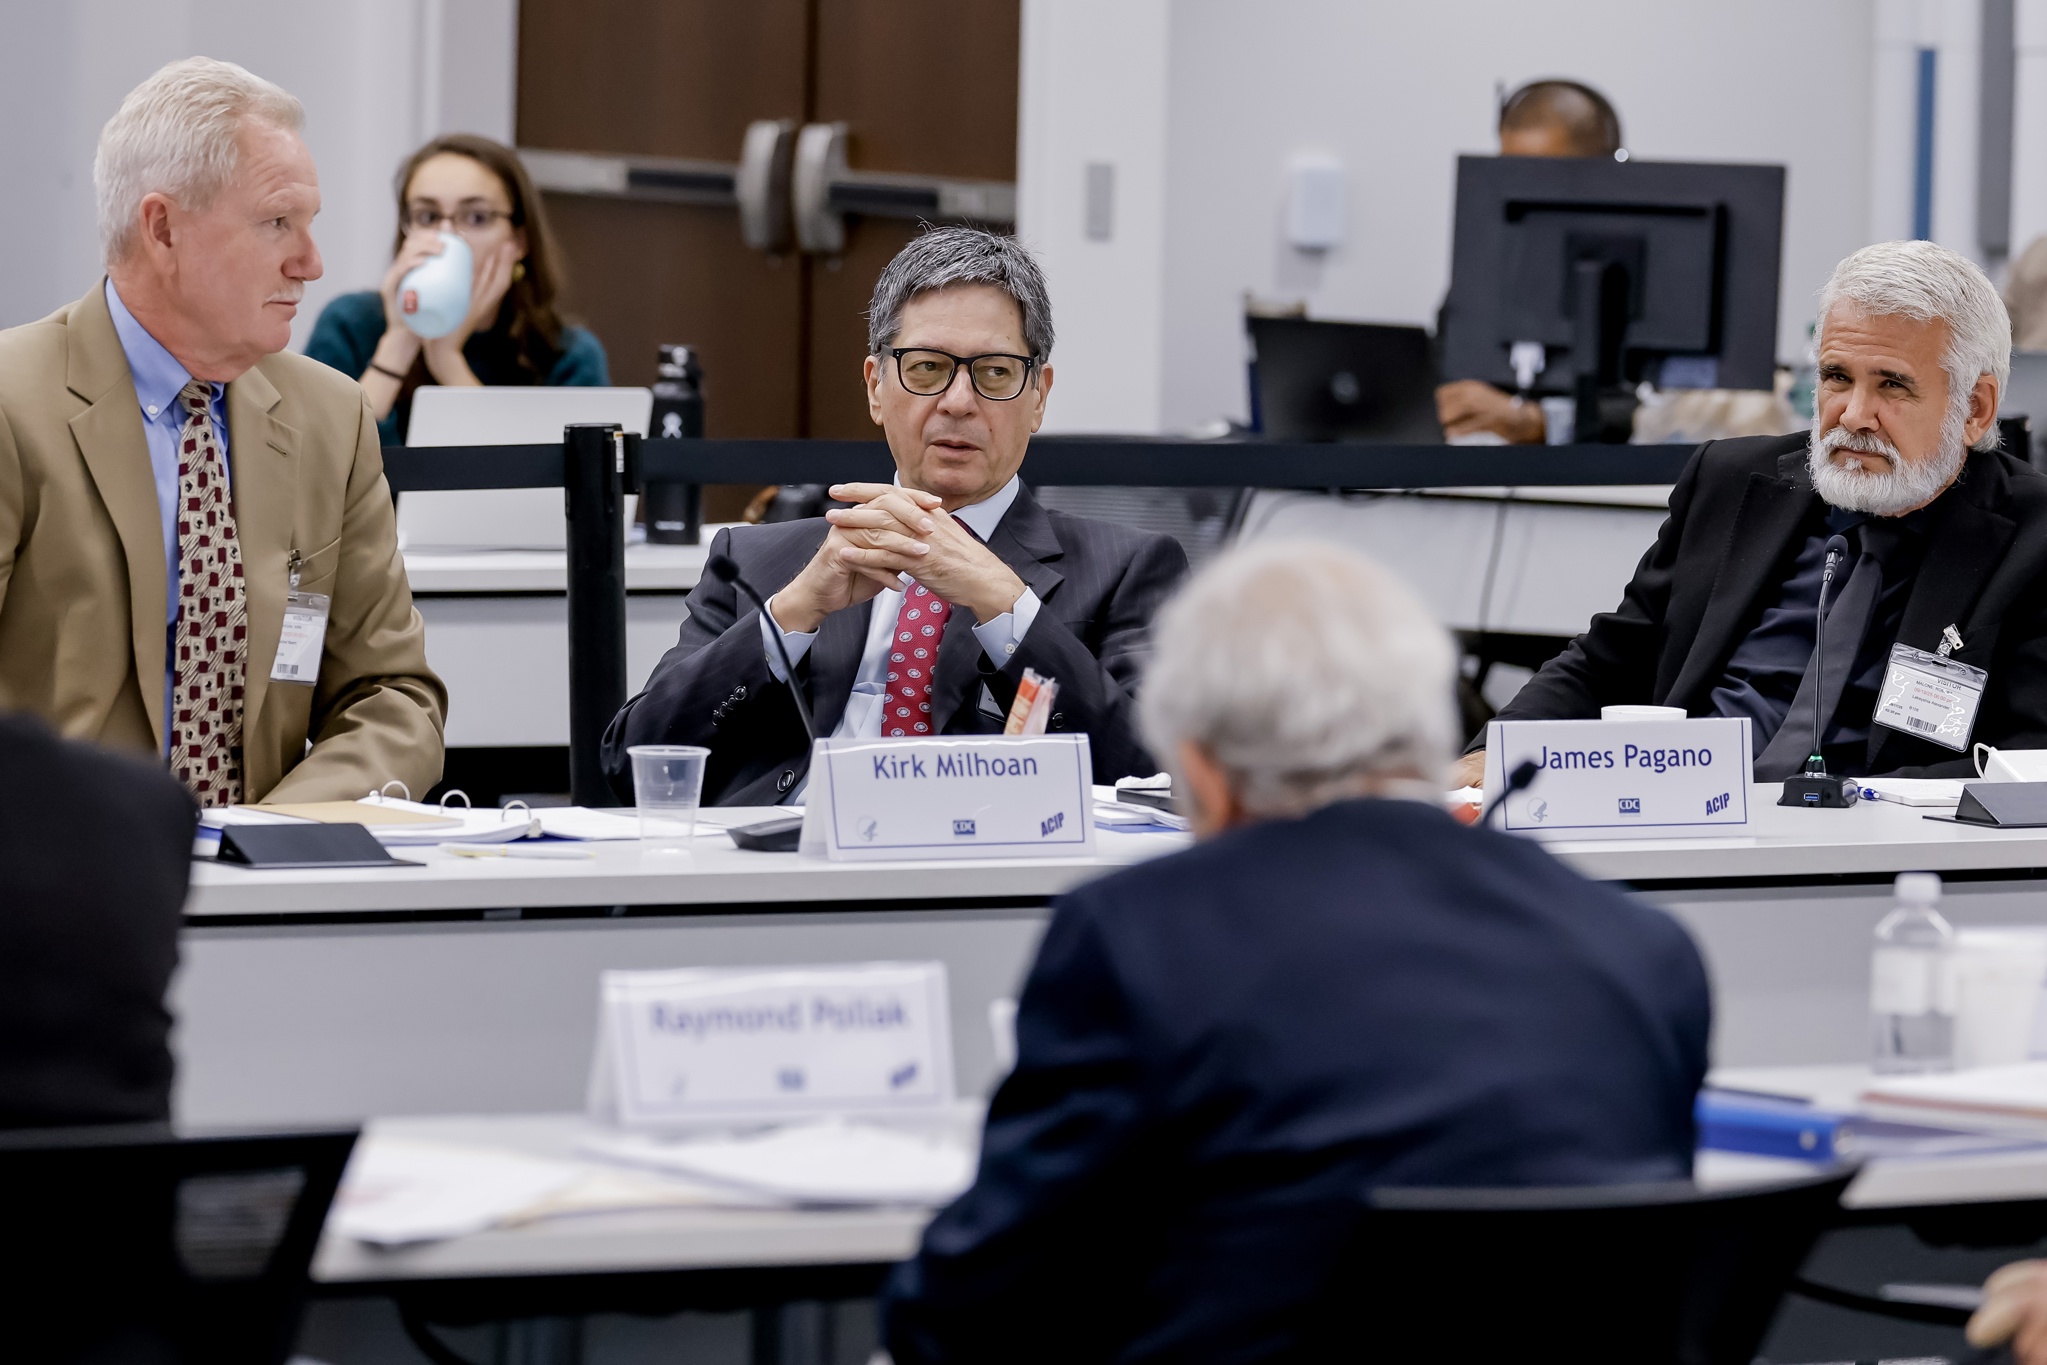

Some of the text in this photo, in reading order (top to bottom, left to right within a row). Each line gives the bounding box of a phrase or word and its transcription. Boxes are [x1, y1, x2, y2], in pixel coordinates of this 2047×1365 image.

[1937, 679, 1961, 690] VISITOR
[873, 752, 1038, 779] Kirk Milhoan
[1536, 744, 1712, 773] James Pagano
[1619, 798, 1640, 812] CDC
[1706, 792, 1730, 816] ACIP
[953, 820, 975, 834] CDC
[1040, 812, 1065, 838] ACIP
[652, 1002, 801, 1041] Raymond
